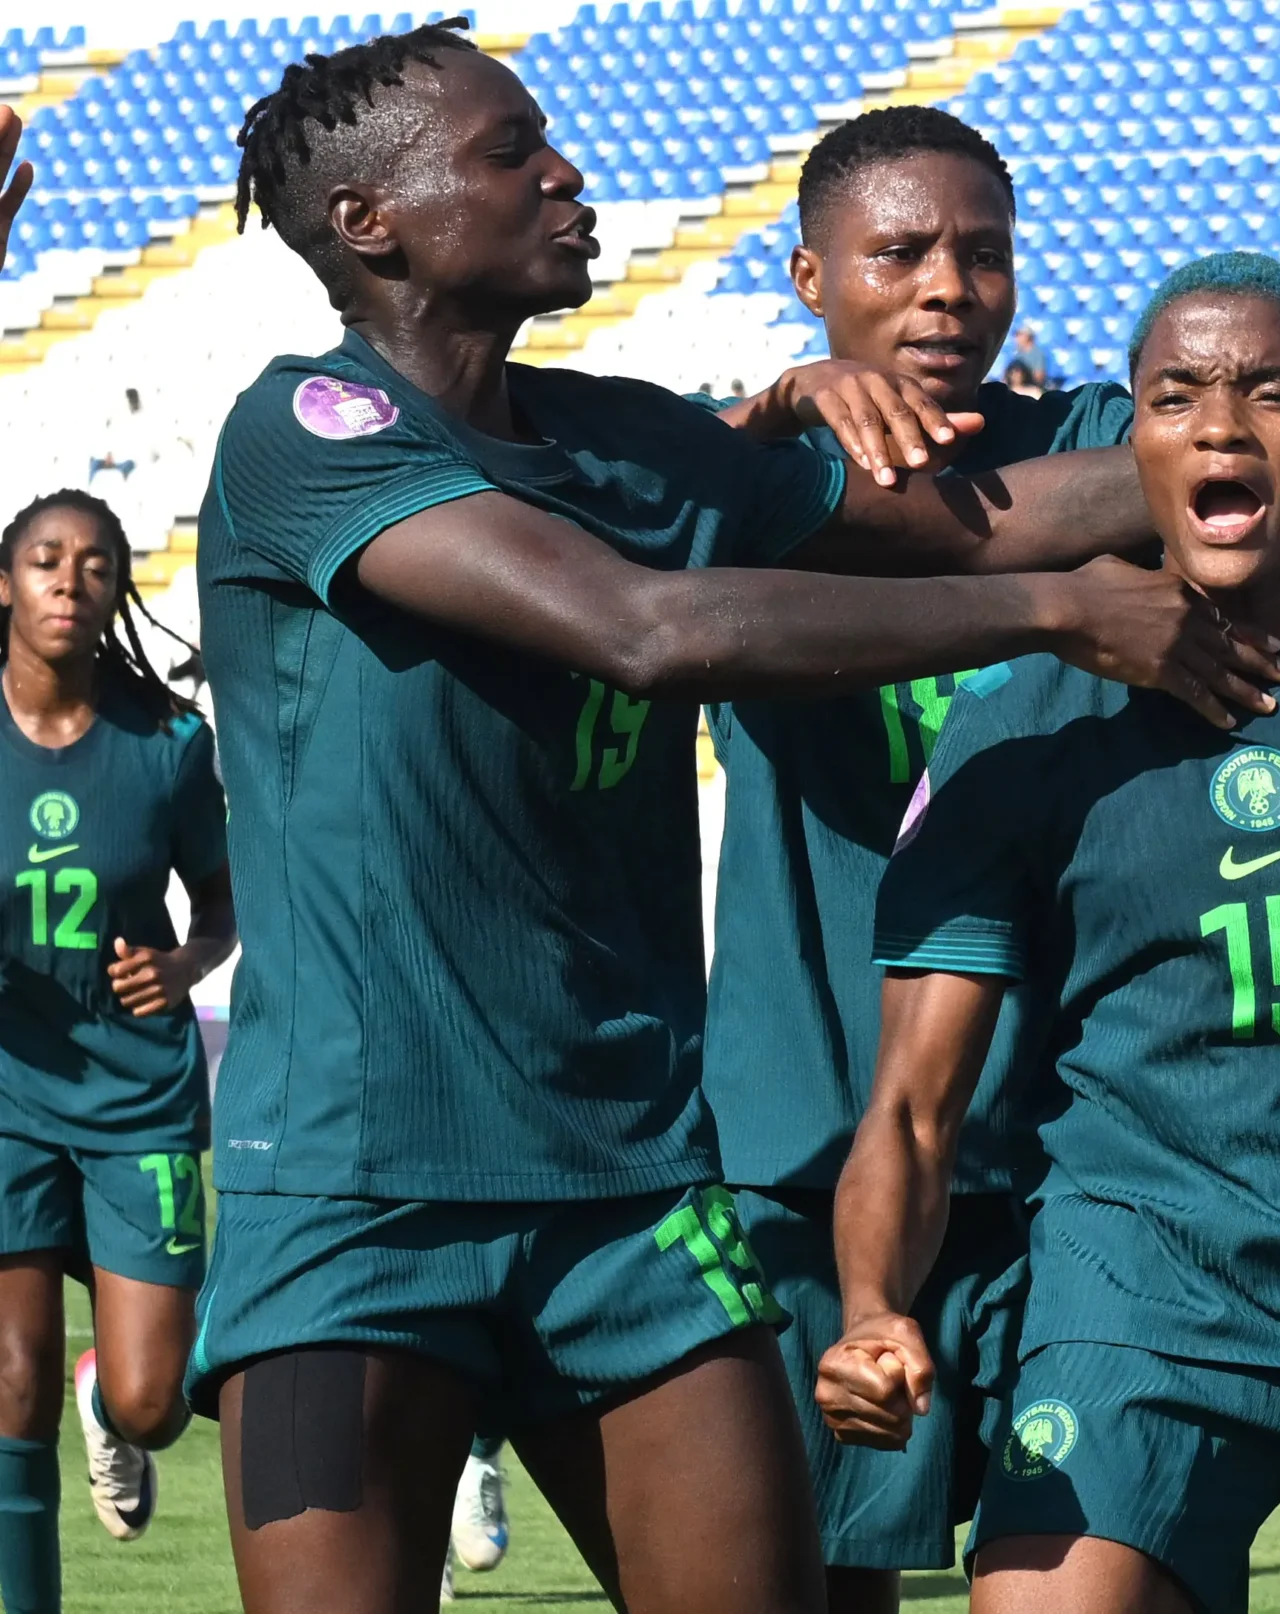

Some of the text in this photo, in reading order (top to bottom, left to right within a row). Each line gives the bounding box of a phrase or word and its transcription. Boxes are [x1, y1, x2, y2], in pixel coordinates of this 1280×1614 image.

[1218, 751, 1267, 783] FOOTBALL
[1215, 784, 1237, 821] NIGERIA
[16, 868, 97, 949] 12
[140, 1153, 201, 1236] 12
[1053, 1406, 1075, 1461] FEDERATION
[1022, 1466, 1043, 1476] 1945
